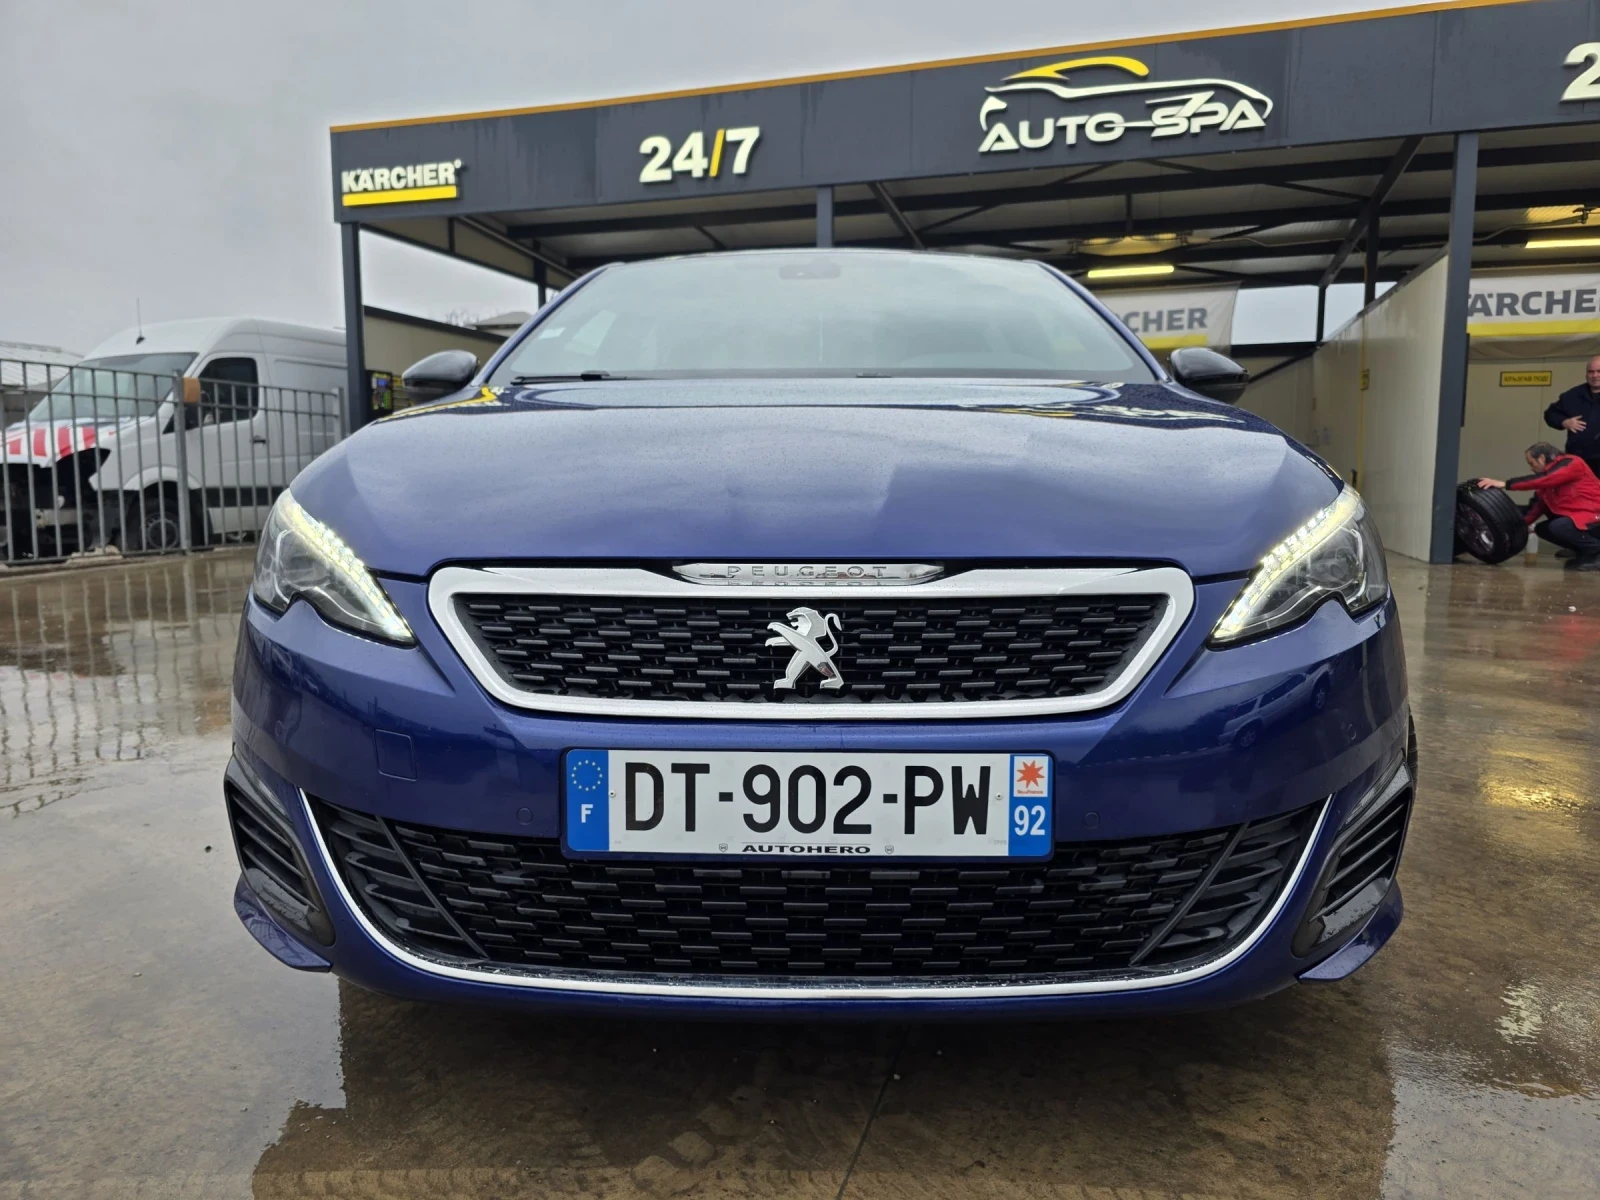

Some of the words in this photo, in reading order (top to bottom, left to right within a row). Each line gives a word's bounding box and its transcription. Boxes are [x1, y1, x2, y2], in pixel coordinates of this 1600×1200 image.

[978, 112, 1125, 153] AUTO
[639, 126, 760, 183] 24/7
[341, 161, 456, 193] KÄRCHER
[1468, 288, 1600, 317] ÄRCHE
[1116, 307, 1208, 333] CHER
[726, 565, 887, 577] PEUGEOT
[581, 804, 594, 823] F
[625, 762, 991, 835] DT-902-PW
[1014, 805, 1046, 836] 92
[742, 844, 871, 854] AUTOHERO
